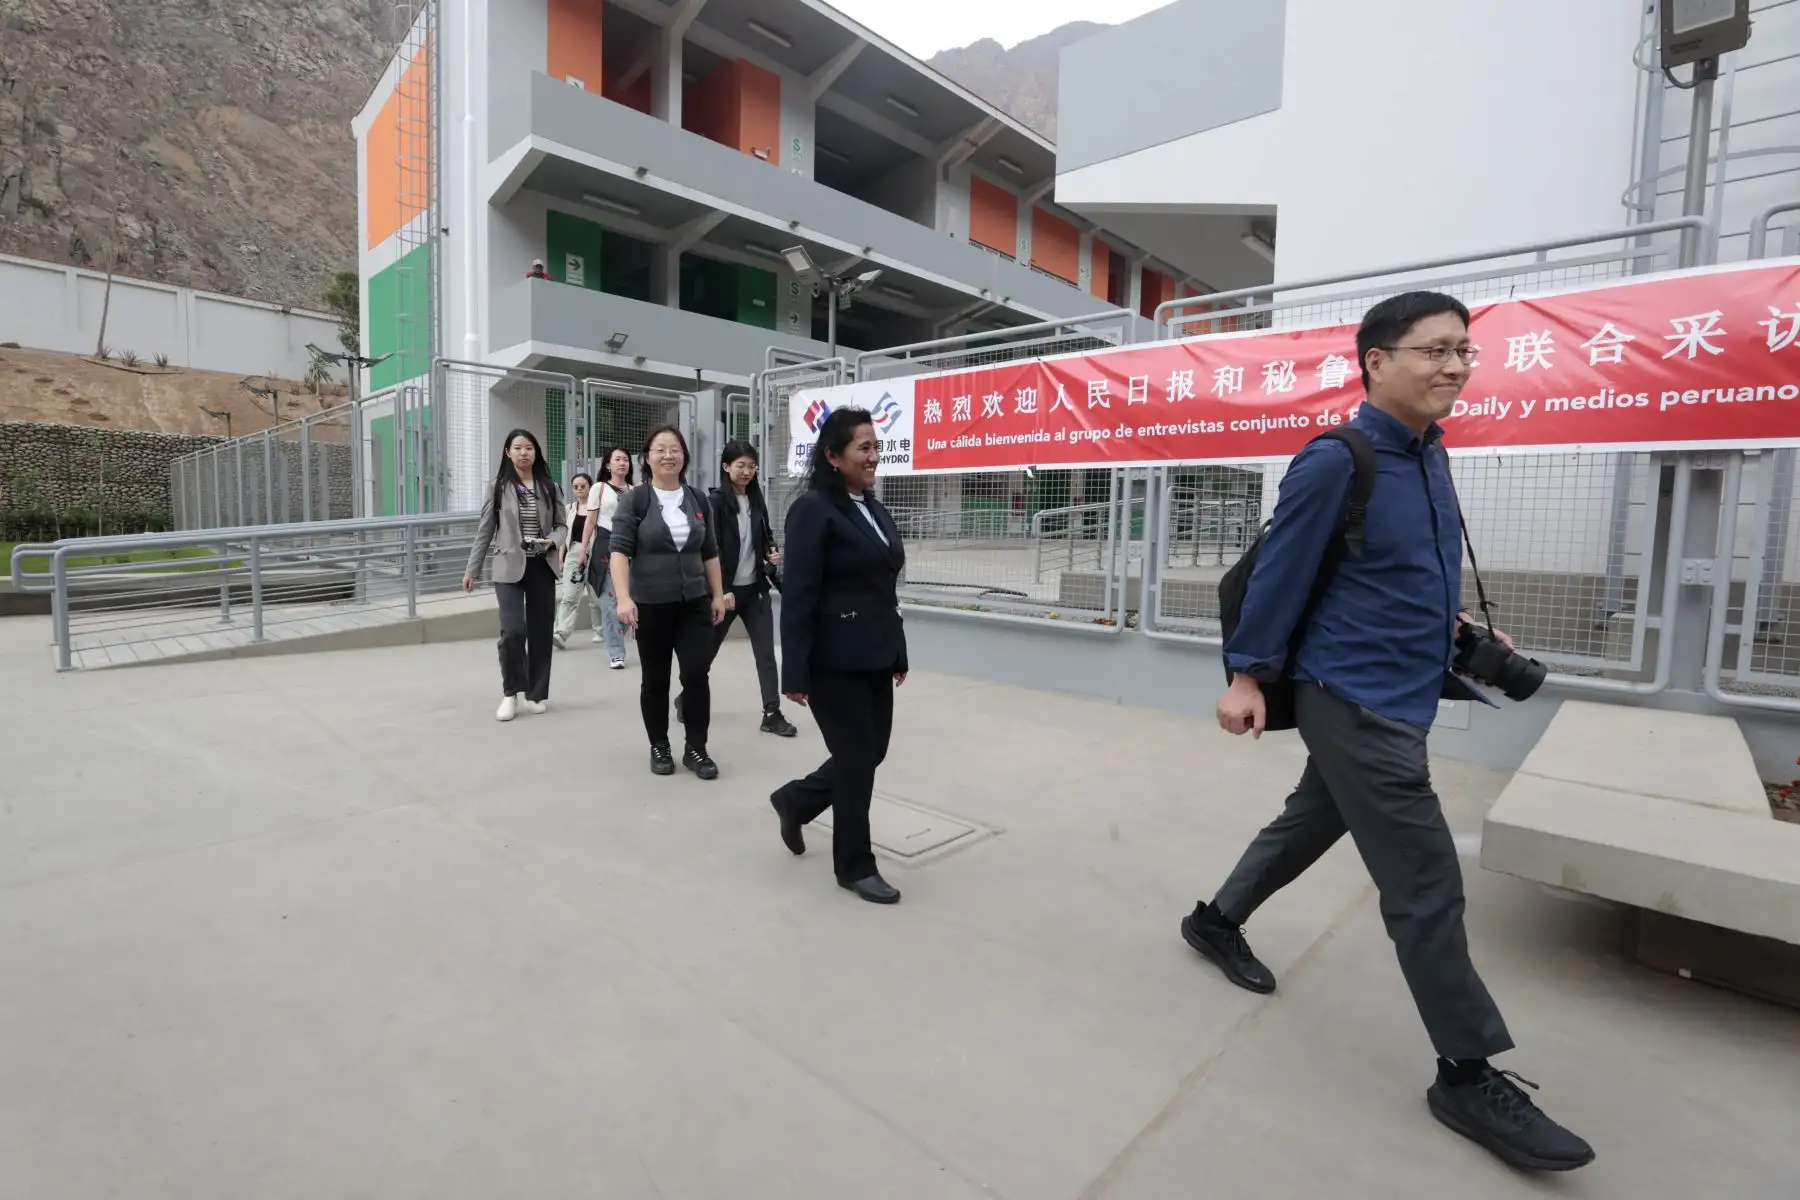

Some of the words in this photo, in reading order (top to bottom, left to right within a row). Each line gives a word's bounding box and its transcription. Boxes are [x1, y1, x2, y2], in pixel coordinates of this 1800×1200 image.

[923, 302, 1800, 424] 热烈欢迎人民日报和秘鲁联合采访
[927, 438, 947, 450] Una
[950, 434, 981, 449] cálida
[985, 429, 1051, 446] bienvenida
[1054, 427, 1066, 441] al
[1069, 429, 1111, 444] grupo
[1115, 423, 1133, 438] de
[1137, 419, 1225, 437] entrevistas
[1230, 413, 1309, 434] conjunto
[1316, 408, 1341, 426] de
[1450, 396, 1513, 420] Daily
[1519, 399, 1537, 418] y
[1544, 387, 1650, 412] medios
[1660, 383, 1800, 411] peruano
[795, 443, 818, 458] 中国
[877, 437, 910, 453] 国水电
[879, 454, 910, 464] HYDRO
